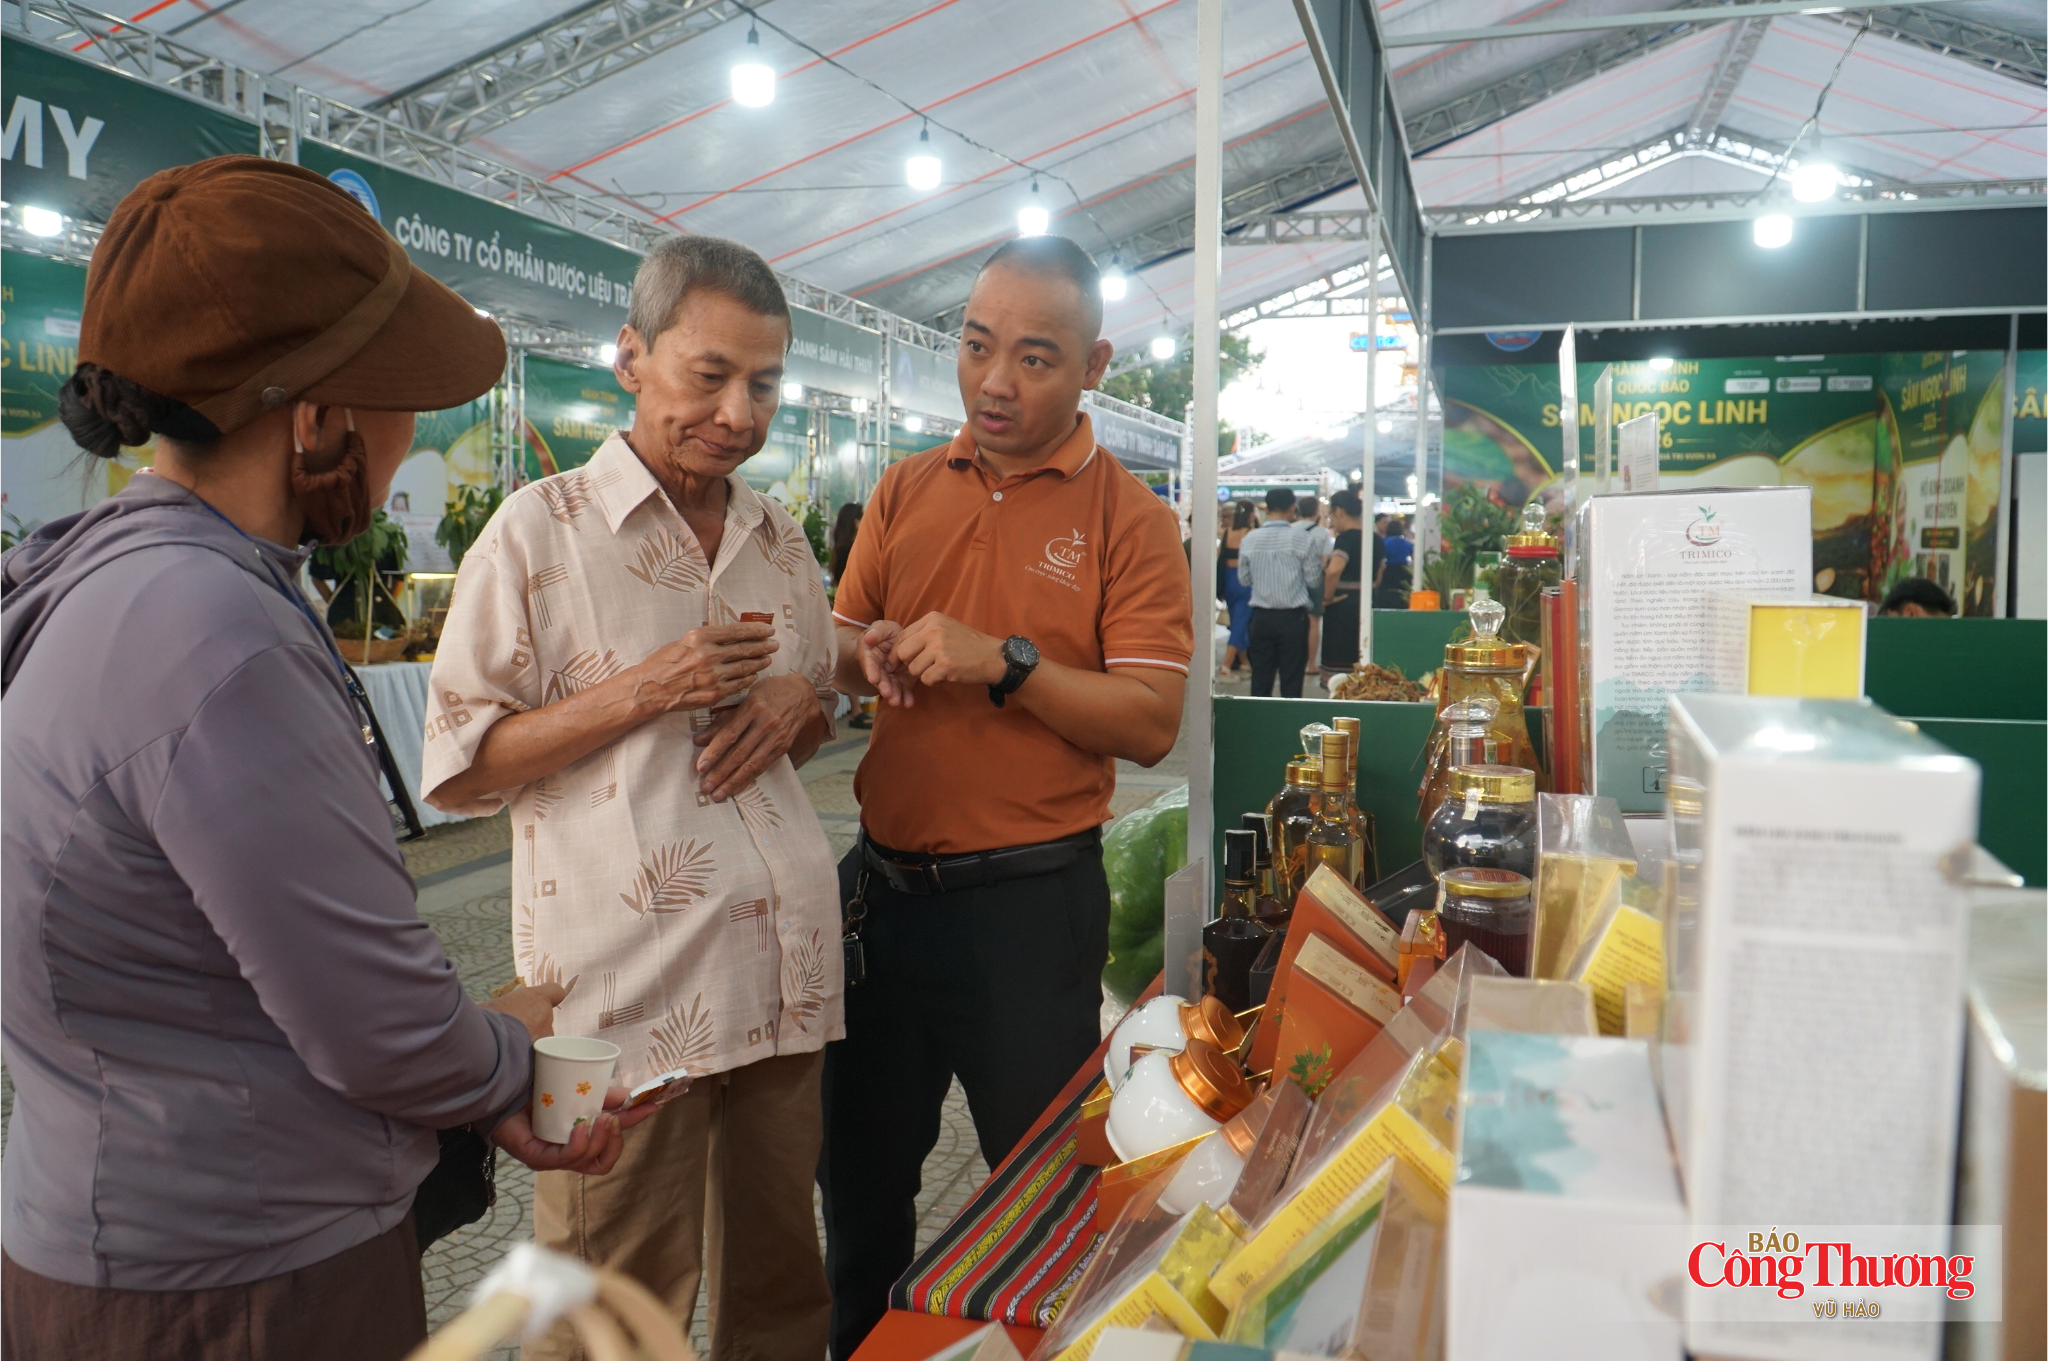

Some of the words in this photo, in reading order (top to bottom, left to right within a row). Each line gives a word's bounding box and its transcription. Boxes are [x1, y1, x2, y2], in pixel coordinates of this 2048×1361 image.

[1, 94, 104, 181] MY
[395, 213, 450, 256] CÔNG
[454, 233, 473, 263] TY
[477, 231, 501, 270] CỔ
[505, 244, 544, 284] PHẦN
[547, 262, 586, 299] DƯỢC
[588, 271, 612, 307] LIỆU
[792, 338, 818, 360] OANH
[2013, 386, 2048, 419] SÂ
[1541, 403, 1596, 428] SM
[1697, 400, 1768, 424] LINH
[1697, 525, 1720, 536] TM
[1060, 545, 1081, 564] TM
[1679, 550, 1732, 559] TRIMICO
[1038, 561, 1076, 581] TRIMICO
